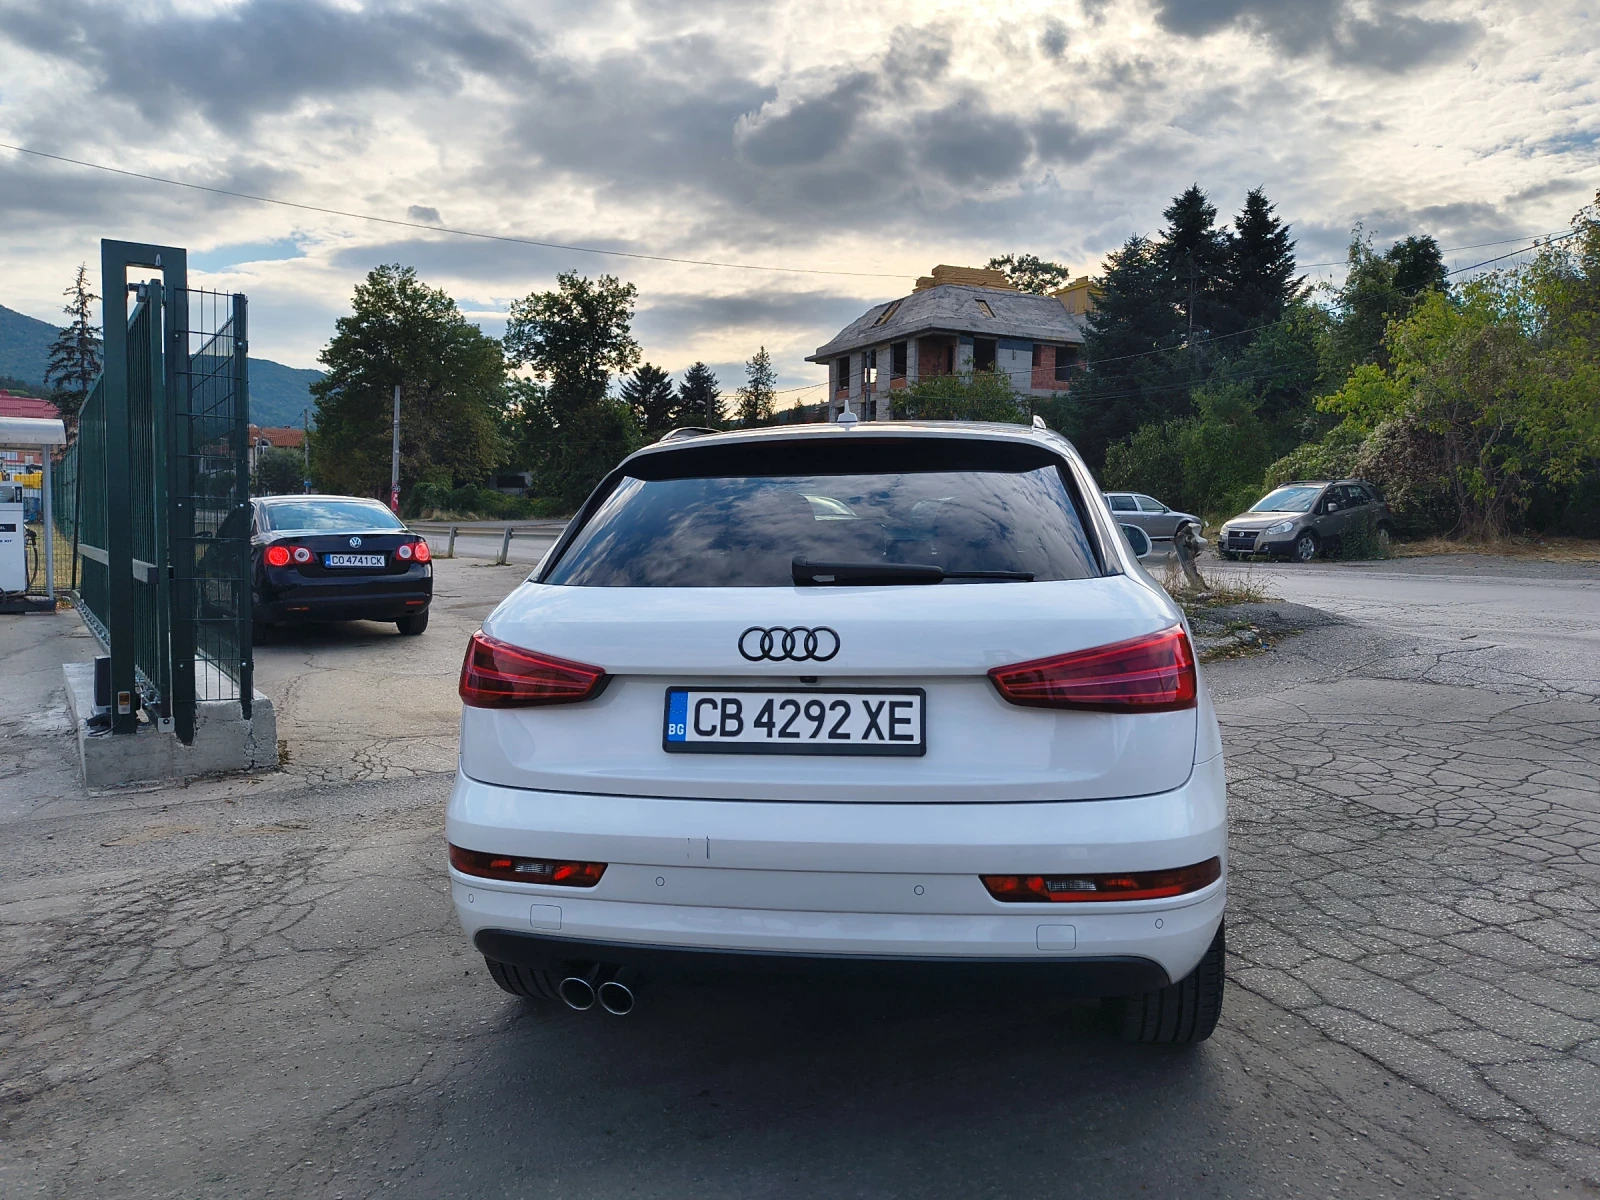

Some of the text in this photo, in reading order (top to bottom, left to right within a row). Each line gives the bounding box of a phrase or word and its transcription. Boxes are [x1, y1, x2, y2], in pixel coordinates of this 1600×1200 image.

[331, 555, 383, 566] CO 4741 CK
[693, 697, 915, 742] CB 4292 XE
[668, 723, 685, 736] BG
